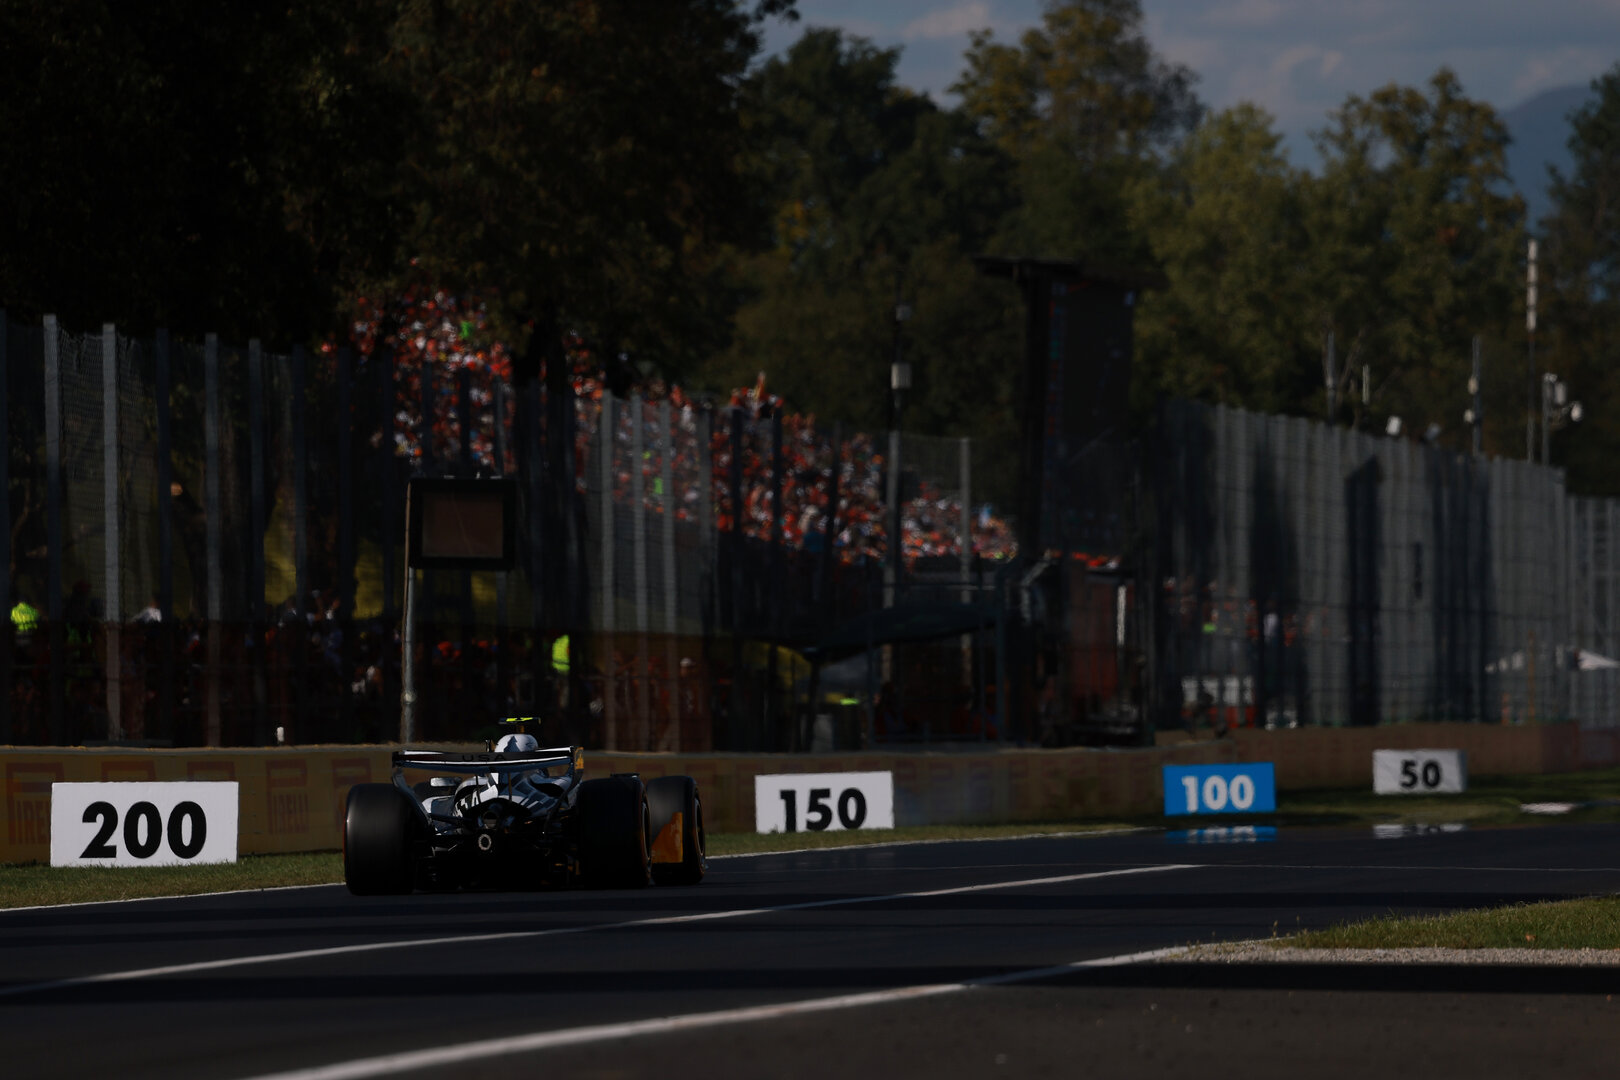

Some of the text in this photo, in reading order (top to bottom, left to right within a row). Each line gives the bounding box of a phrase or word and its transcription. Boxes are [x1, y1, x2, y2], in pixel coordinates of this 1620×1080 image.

[1182, 774, 1256, 813] 100
[1400, 759, 1440, 789] 50
[79, 801, 207, 859] 200
[780, 788, 866, 832] 150
